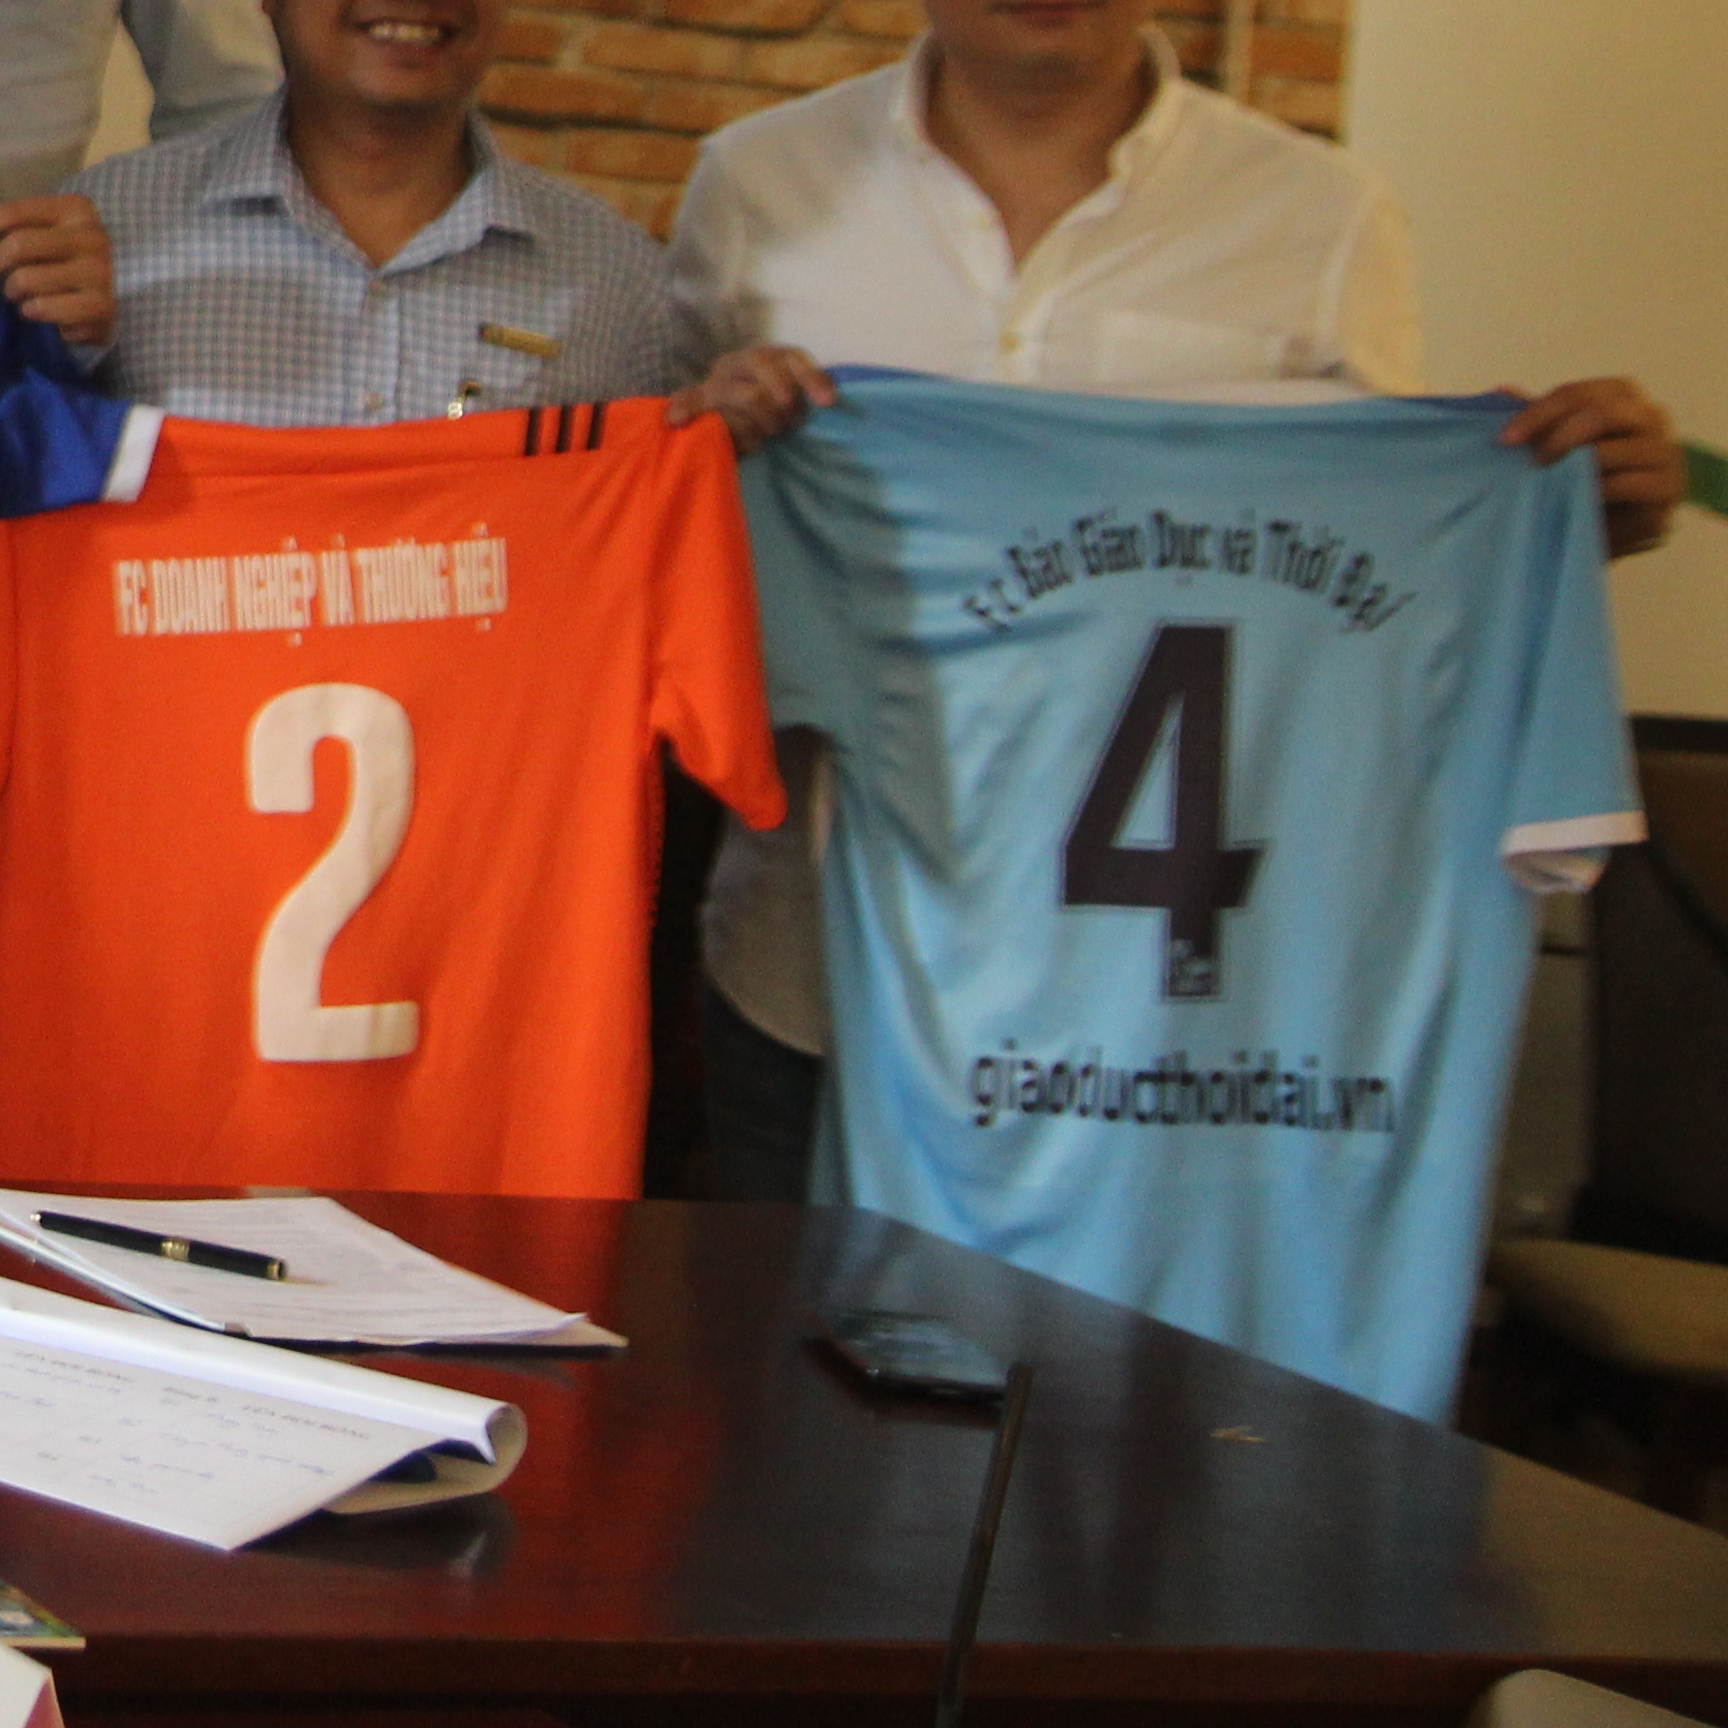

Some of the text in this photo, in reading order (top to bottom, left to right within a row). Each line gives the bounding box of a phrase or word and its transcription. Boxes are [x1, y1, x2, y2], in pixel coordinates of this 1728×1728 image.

[115, 559, 147, 635] FC
[247, 681, 420, 1063] 2
[1056, 617, 1275, 1003] 4
